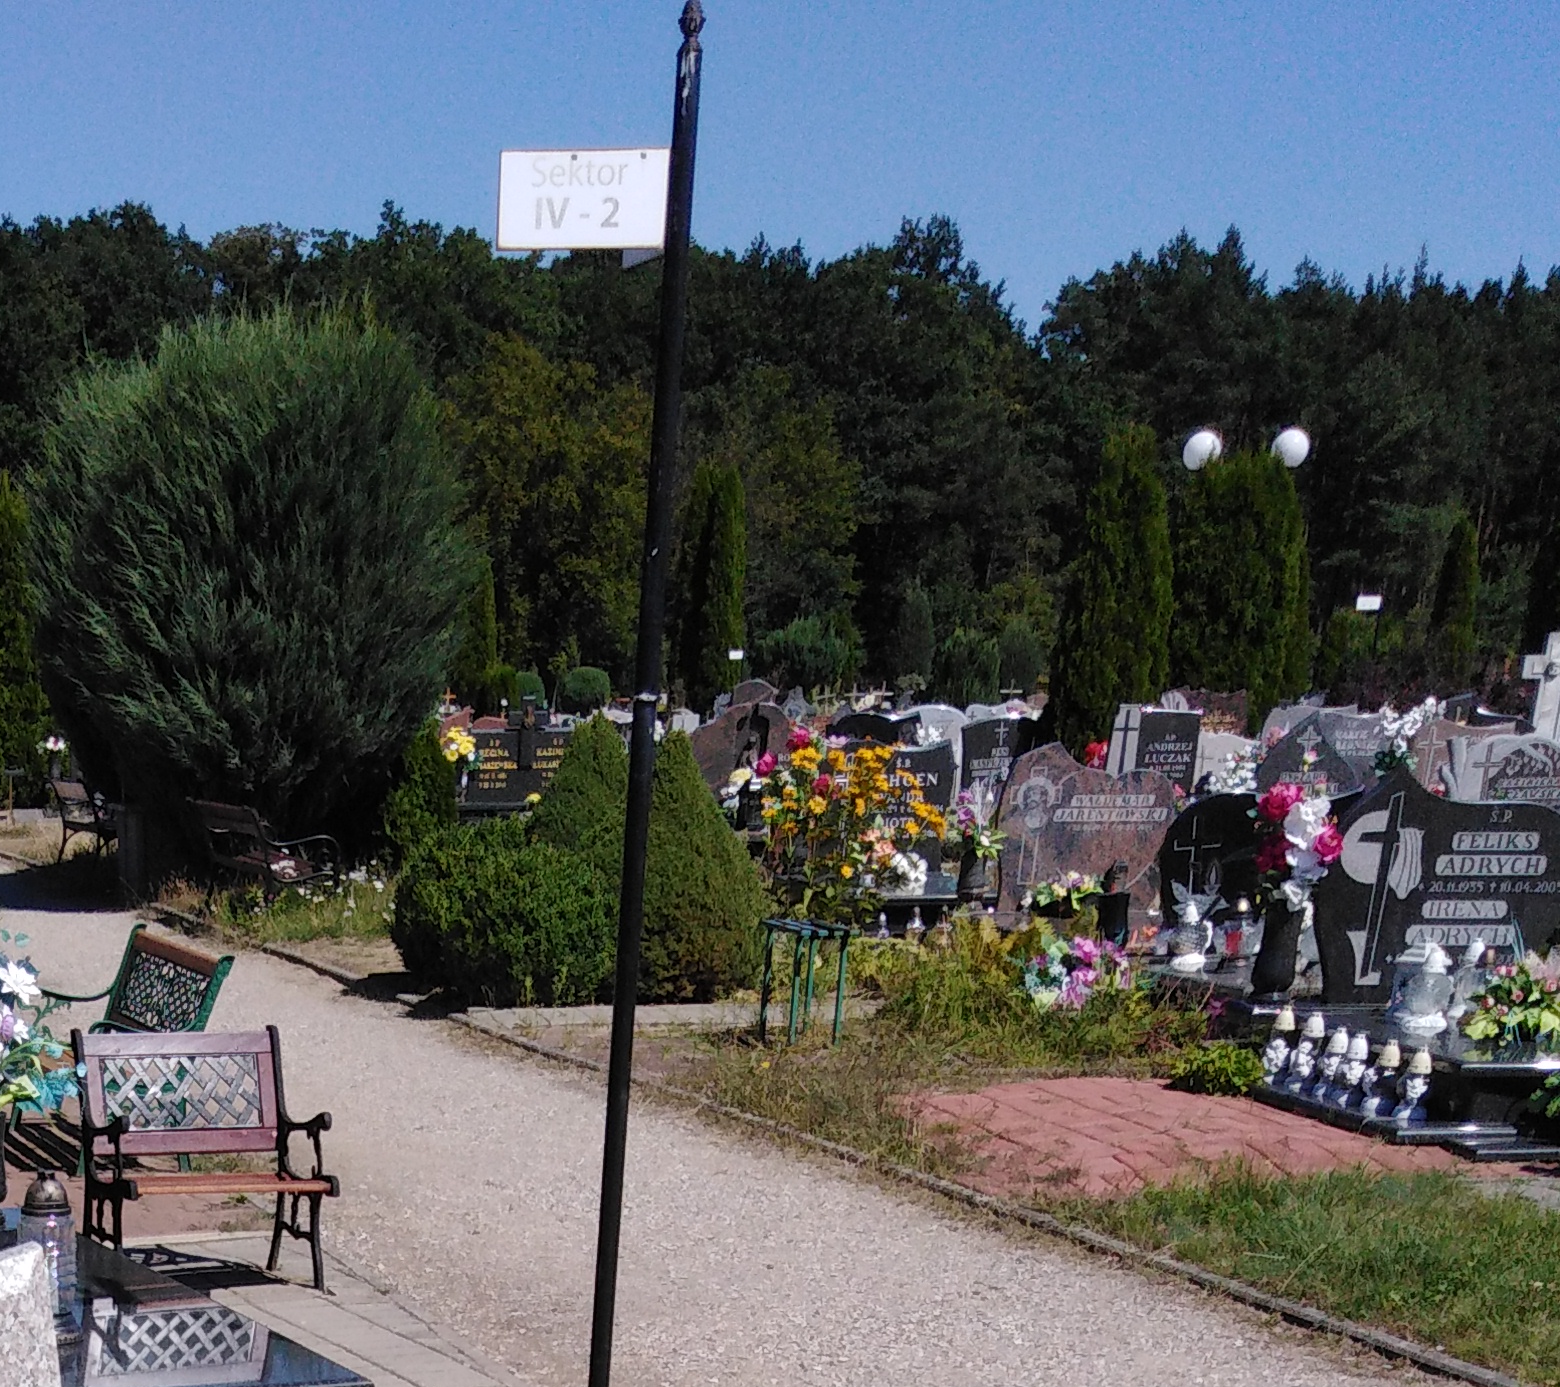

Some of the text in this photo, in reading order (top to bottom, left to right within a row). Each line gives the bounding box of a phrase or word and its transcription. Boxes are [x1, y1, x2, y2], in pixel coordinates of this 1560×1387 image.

[531, 155, 628, 187] Sektor
[535, 197, 570, 230] IV
[600, 197, 620, 228] 2
[1146, 741, 1193, 752] ANDRZEJ
[1456, 833, 1535, 849] FELIKS
[1441, 856, 1543, 875] ADRYCH
[1427, 901, 1501, 917] IRENA
[1410, 928, 1510, 947] ADRYCH
